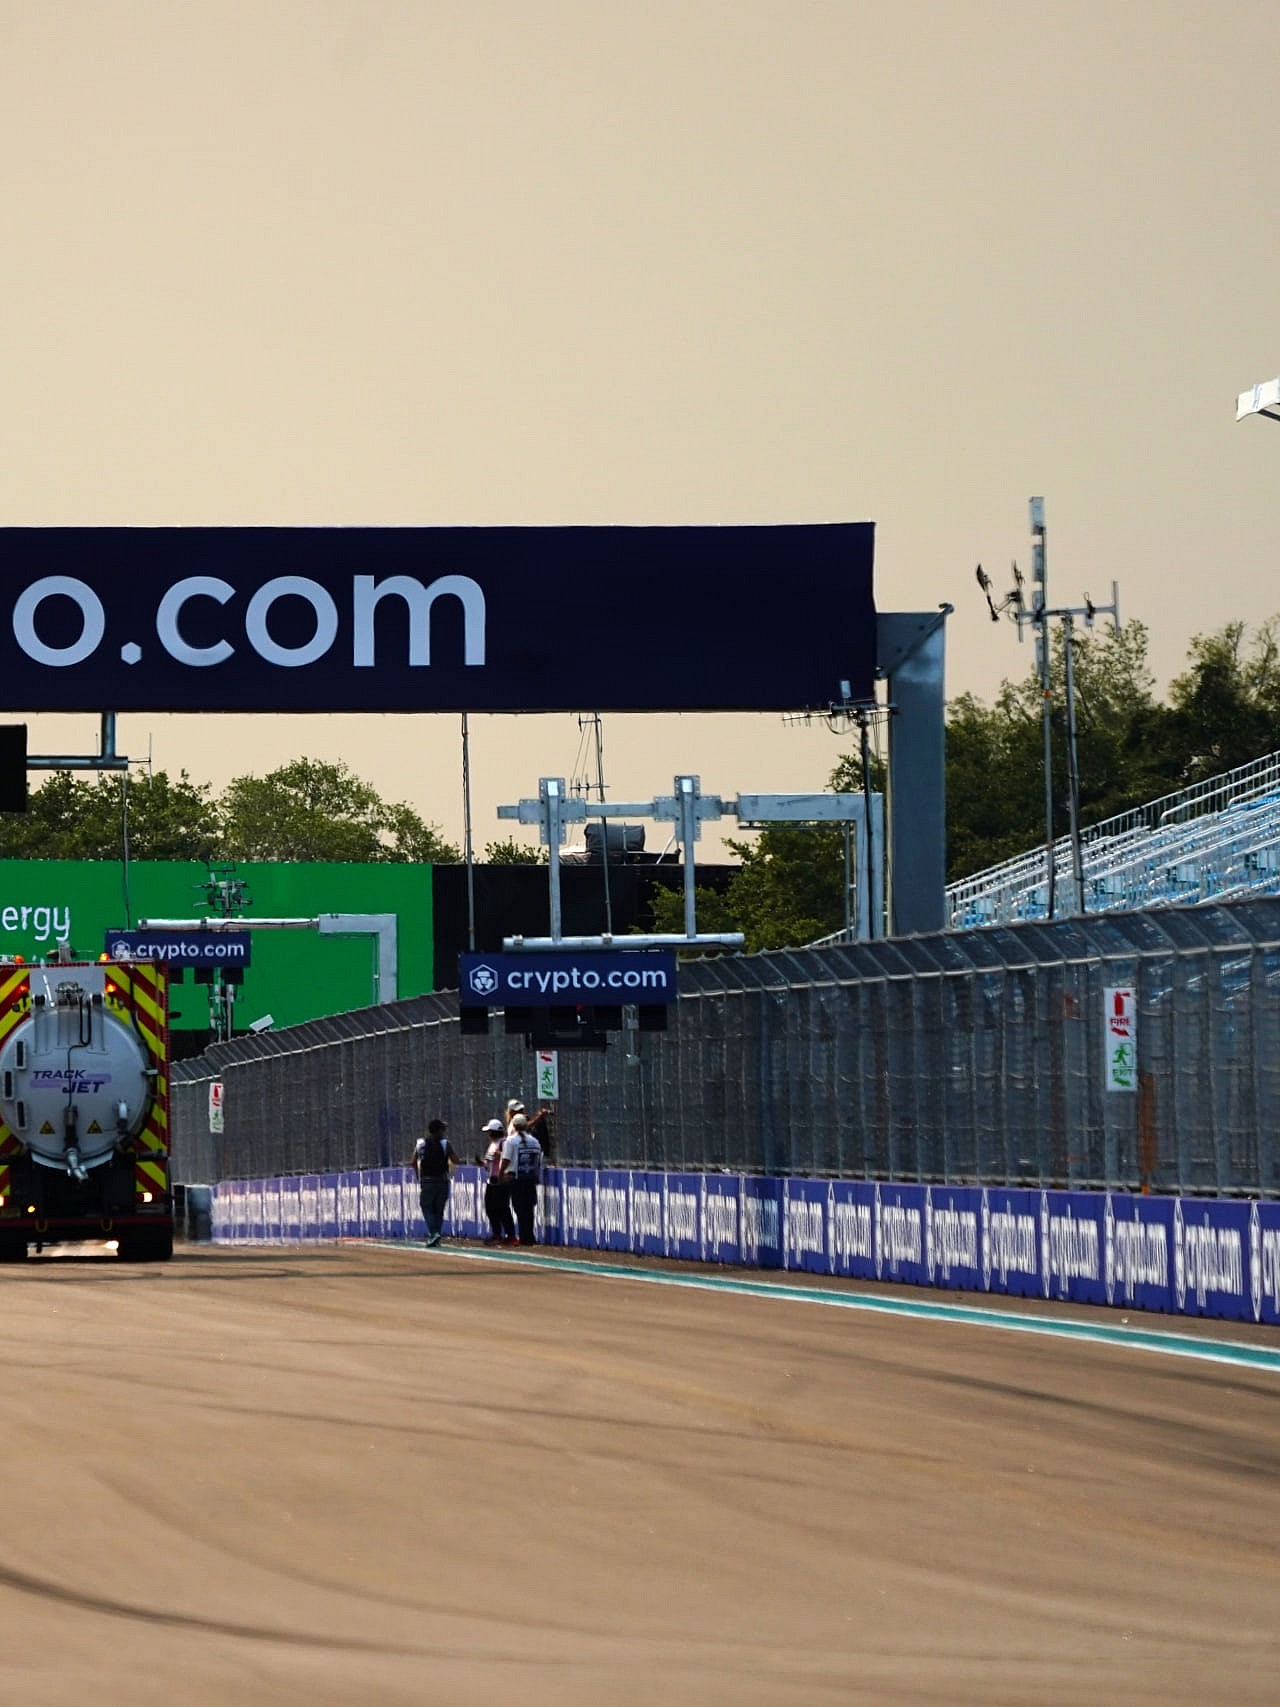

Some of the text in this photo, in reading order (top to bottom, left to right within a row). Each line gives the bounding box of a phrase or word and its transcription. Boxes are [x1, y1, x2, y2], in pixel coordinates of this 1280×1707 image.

[136, 941, 245, 960] crypto.com
[507, 967, 667, 993] crypto.com
[32, 1069, 87, 1080] TRACK
[61, 1081, 105, 1094] JET
